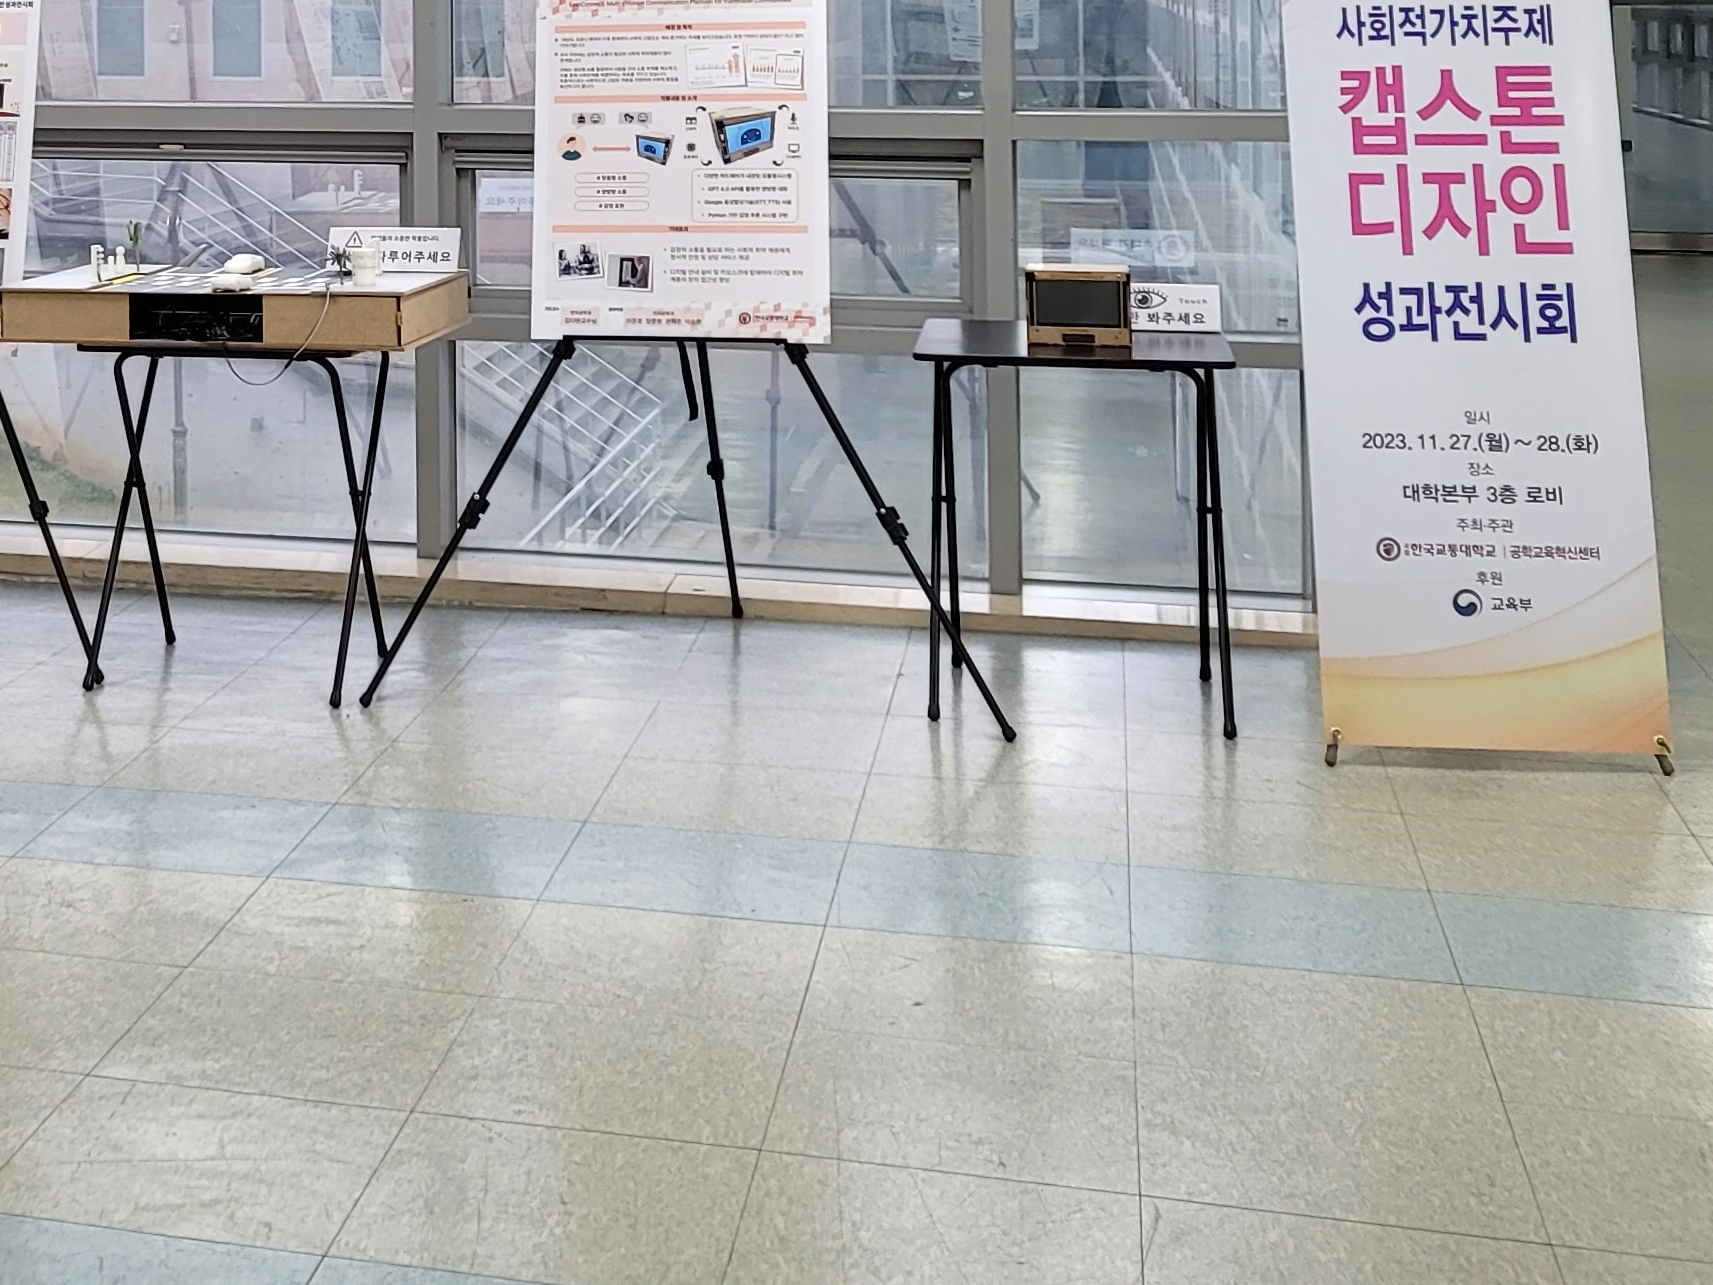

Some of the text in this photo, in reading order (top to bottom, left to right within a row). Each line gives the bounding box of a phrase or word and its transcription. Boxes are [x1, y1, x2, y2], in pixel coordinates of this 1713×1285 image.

[1336, 3, 1554, 46] 사회적가치주제
[1339, 65, 1565, 155] 캡스톤
[1348, 163, 1574, 257] 디자인
[1179, 297, 1208, 305] Touch
[1147, 312, 1206, 325] 봐주세요
[1354, 281, 1578, 344] 성과전시회
[1464, 411, 1491, 425] 일시
[1362, 433, 1412, 450] 2023.
[1418, 434, 1445, 451] 11.
[1449, 432, 1510, 453] 27.(월)
[1537, 434, 1599, 454] 28.(화)
[1468, 463, 1494, 476] 장소
[1403, 484, 1563, 505] 대학본부 3층 로비
[1411, 543, 1601, 561] 한국교통대학교 공학교육혁신센터
[1476, 571, 1503, 585] 후원
[1491, 598, 1533, 612] 교육부
